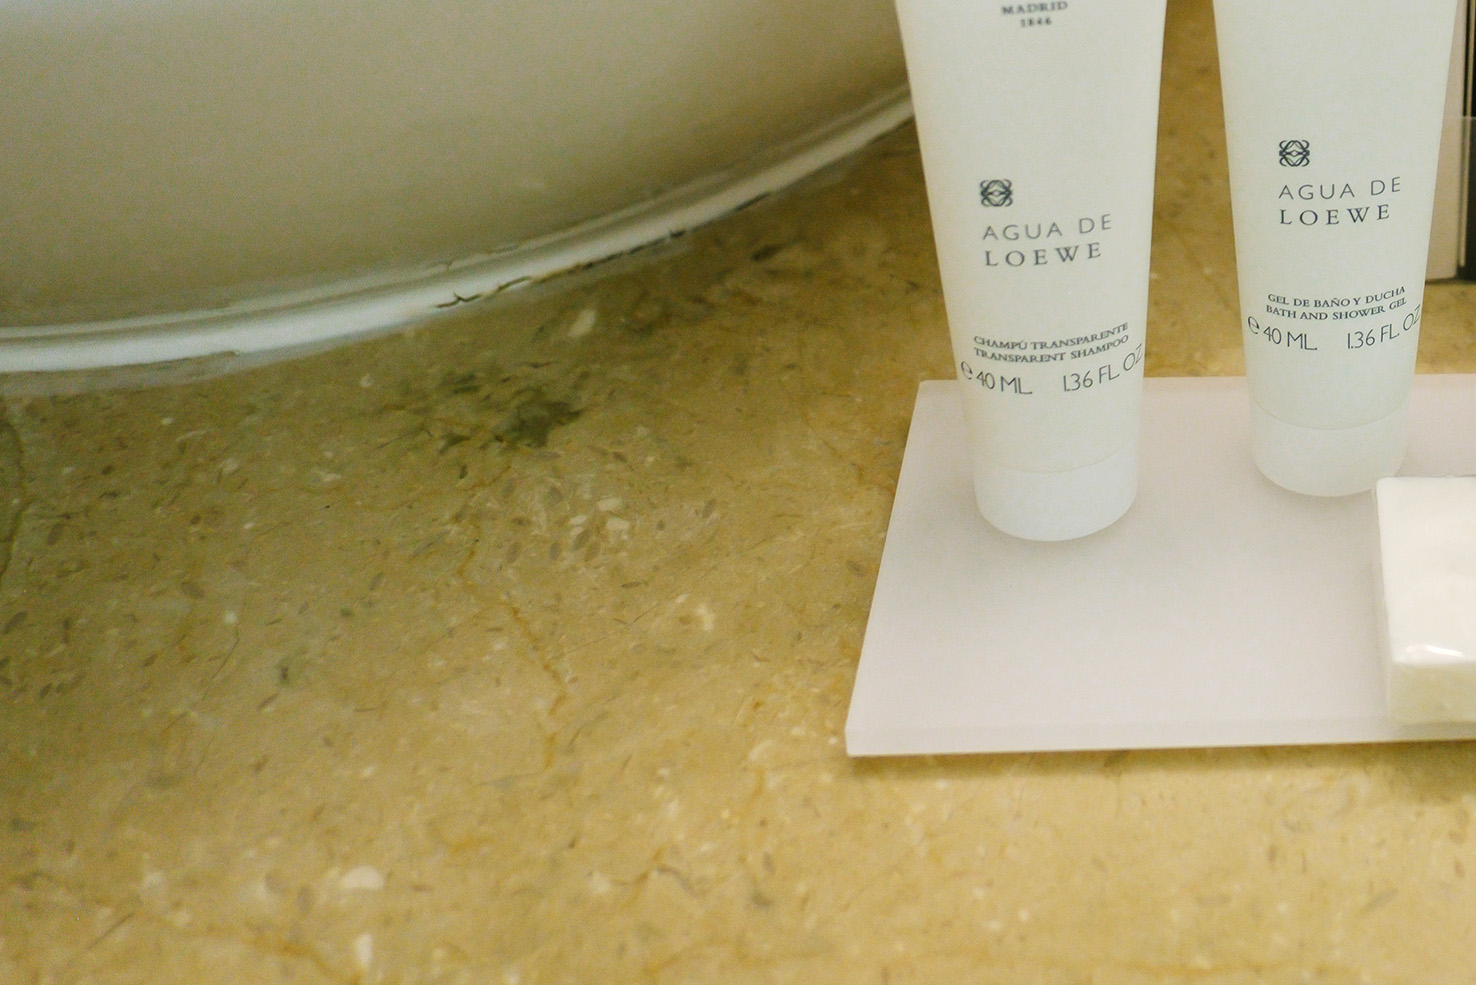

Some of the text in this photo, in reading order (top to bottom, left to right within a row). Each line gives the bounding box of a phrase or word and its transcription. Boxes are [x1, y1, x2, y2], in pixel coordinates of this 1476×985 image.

[1002, 1, 1068, 15] MADRID
[1020, 17, 1052, 28] 1846
[1278, 176, 1401, 200] AGUA DE
[1280, 204, 1390, 226] LOEWE
[982, 214, 1112, 241] AGUA DE
[985, 242, 1102, 267] LOEWE
[1267, 286, 1406, 308] GEL DE BAÑO Y DUCHA
[1266, 297, 1408, 321] BATH AND SHOWER GEL
[974, 322, 1129, 350] CHAMPÚ TRANSPARENTE
[1263, 326, 1282, 345] 40
[974, 334, 1129, 363] TRANSPARENT SHAMPOO
[976, 371, 996, 390] 40
